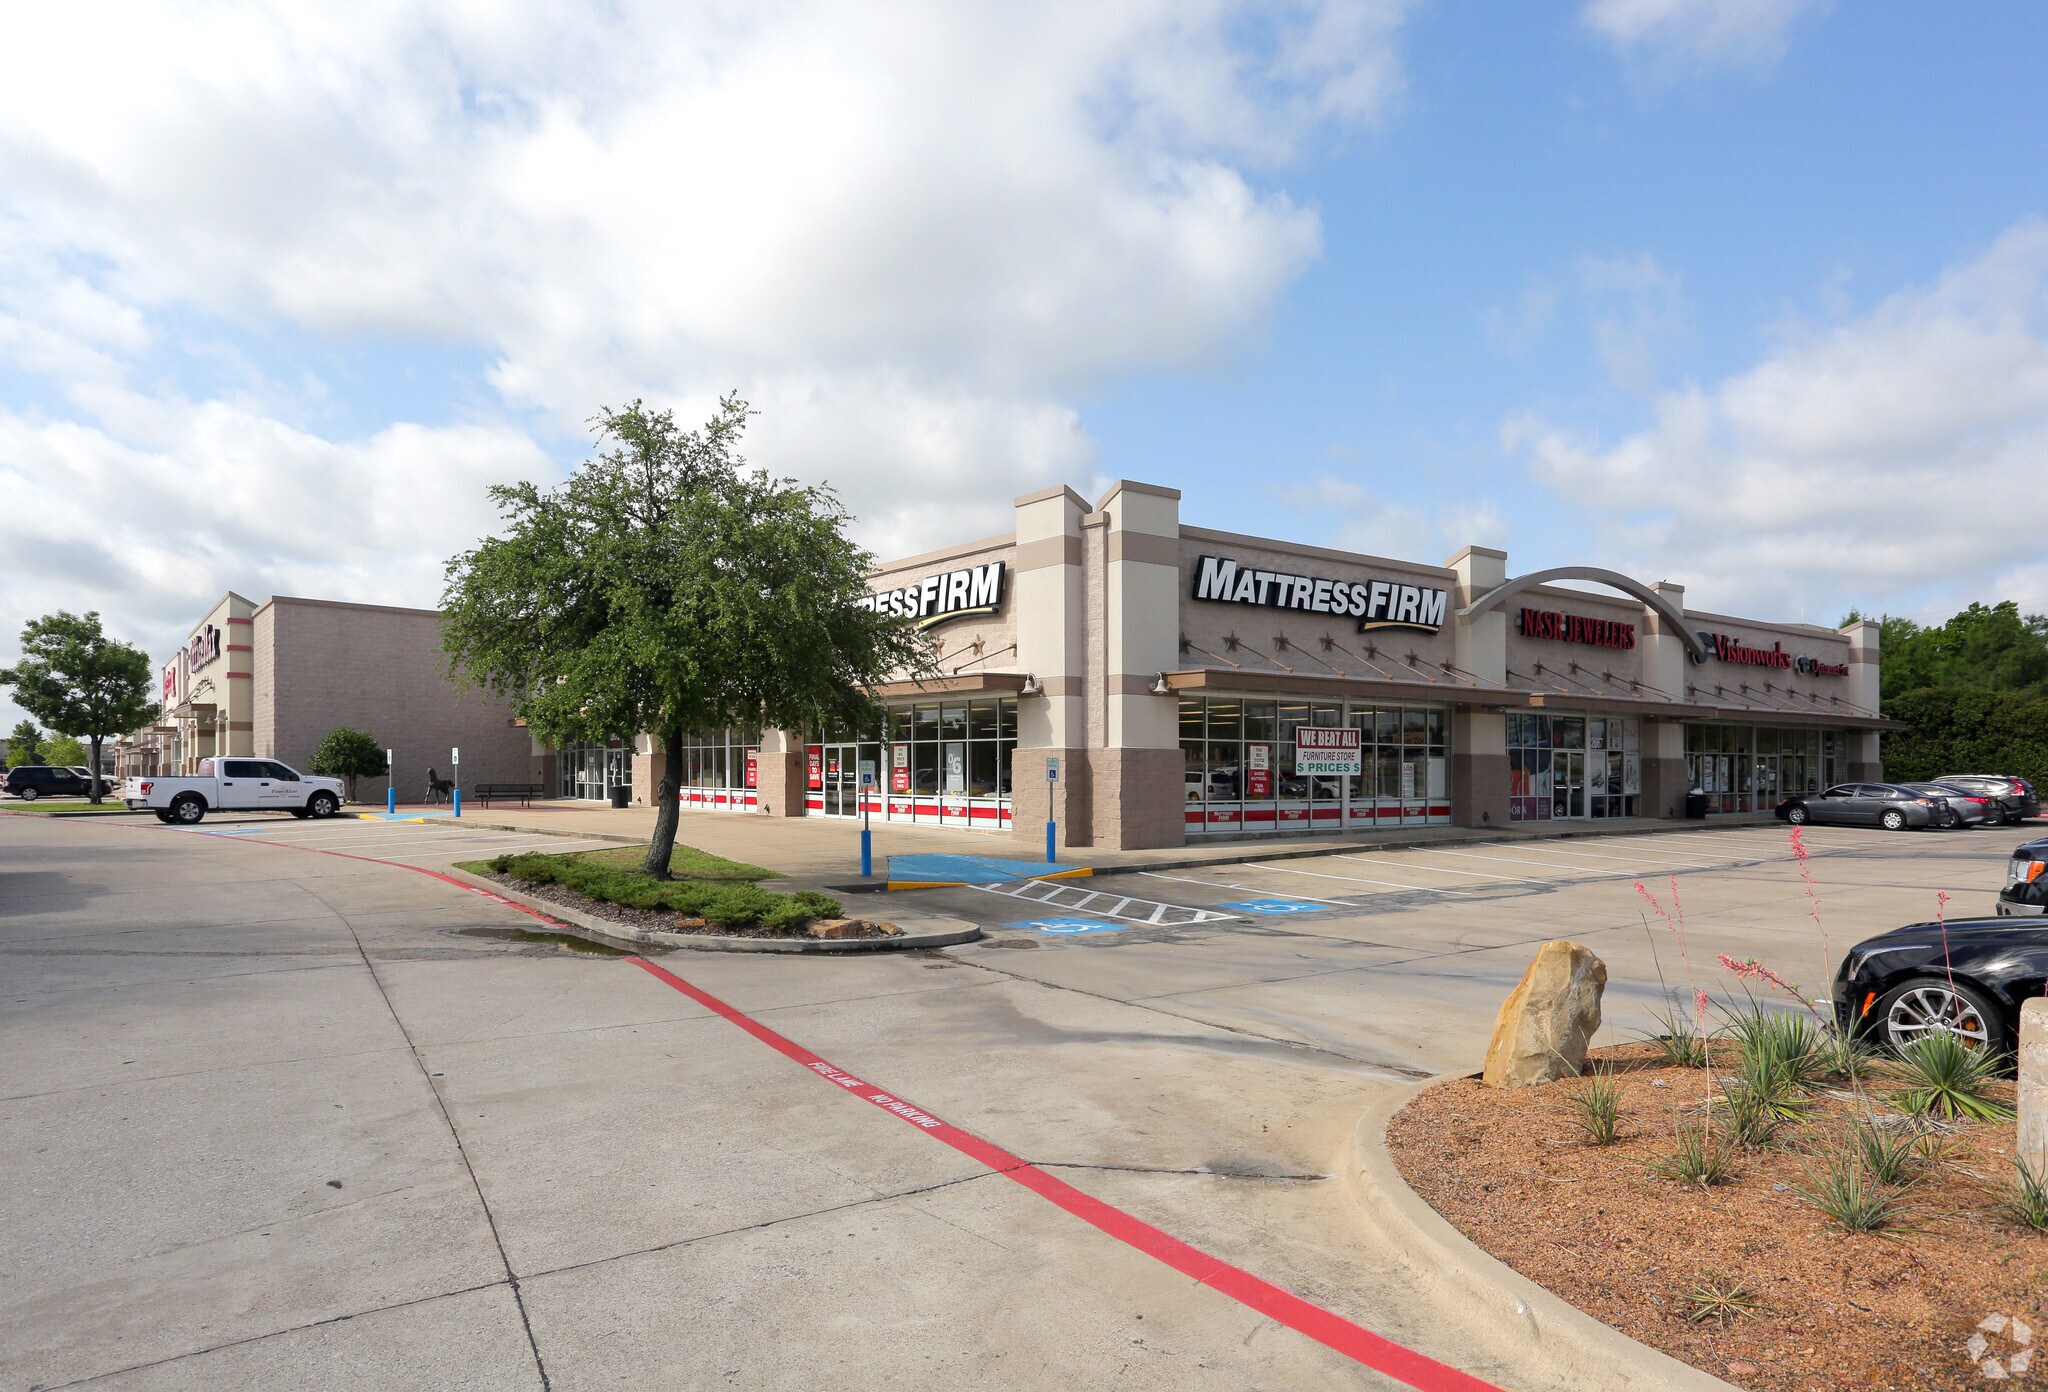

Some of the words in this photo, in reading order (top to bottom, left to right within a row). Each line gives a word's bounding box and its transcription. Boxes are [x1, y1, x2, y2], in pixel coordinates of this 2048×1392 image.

[1521, 607, 1563, 641] NASR
[1566, 614, 1636, 650] JEWELERS
[1711, 633, 1793, 670] Visionworks
[1301, 730, 1317, 746] WE
[1318, 730, 1342, 747] BEAT
[1342, 731, 1357, 747] ALL
[1303, 751, 1336, 761] FURNITURE
[1336, 752, 1355, 761] STORE
[1308, 763, 1350, 772] PRICES
[868, 1094, 893, 1103] NO
[883, 1101, 941, 1128] PARKING
